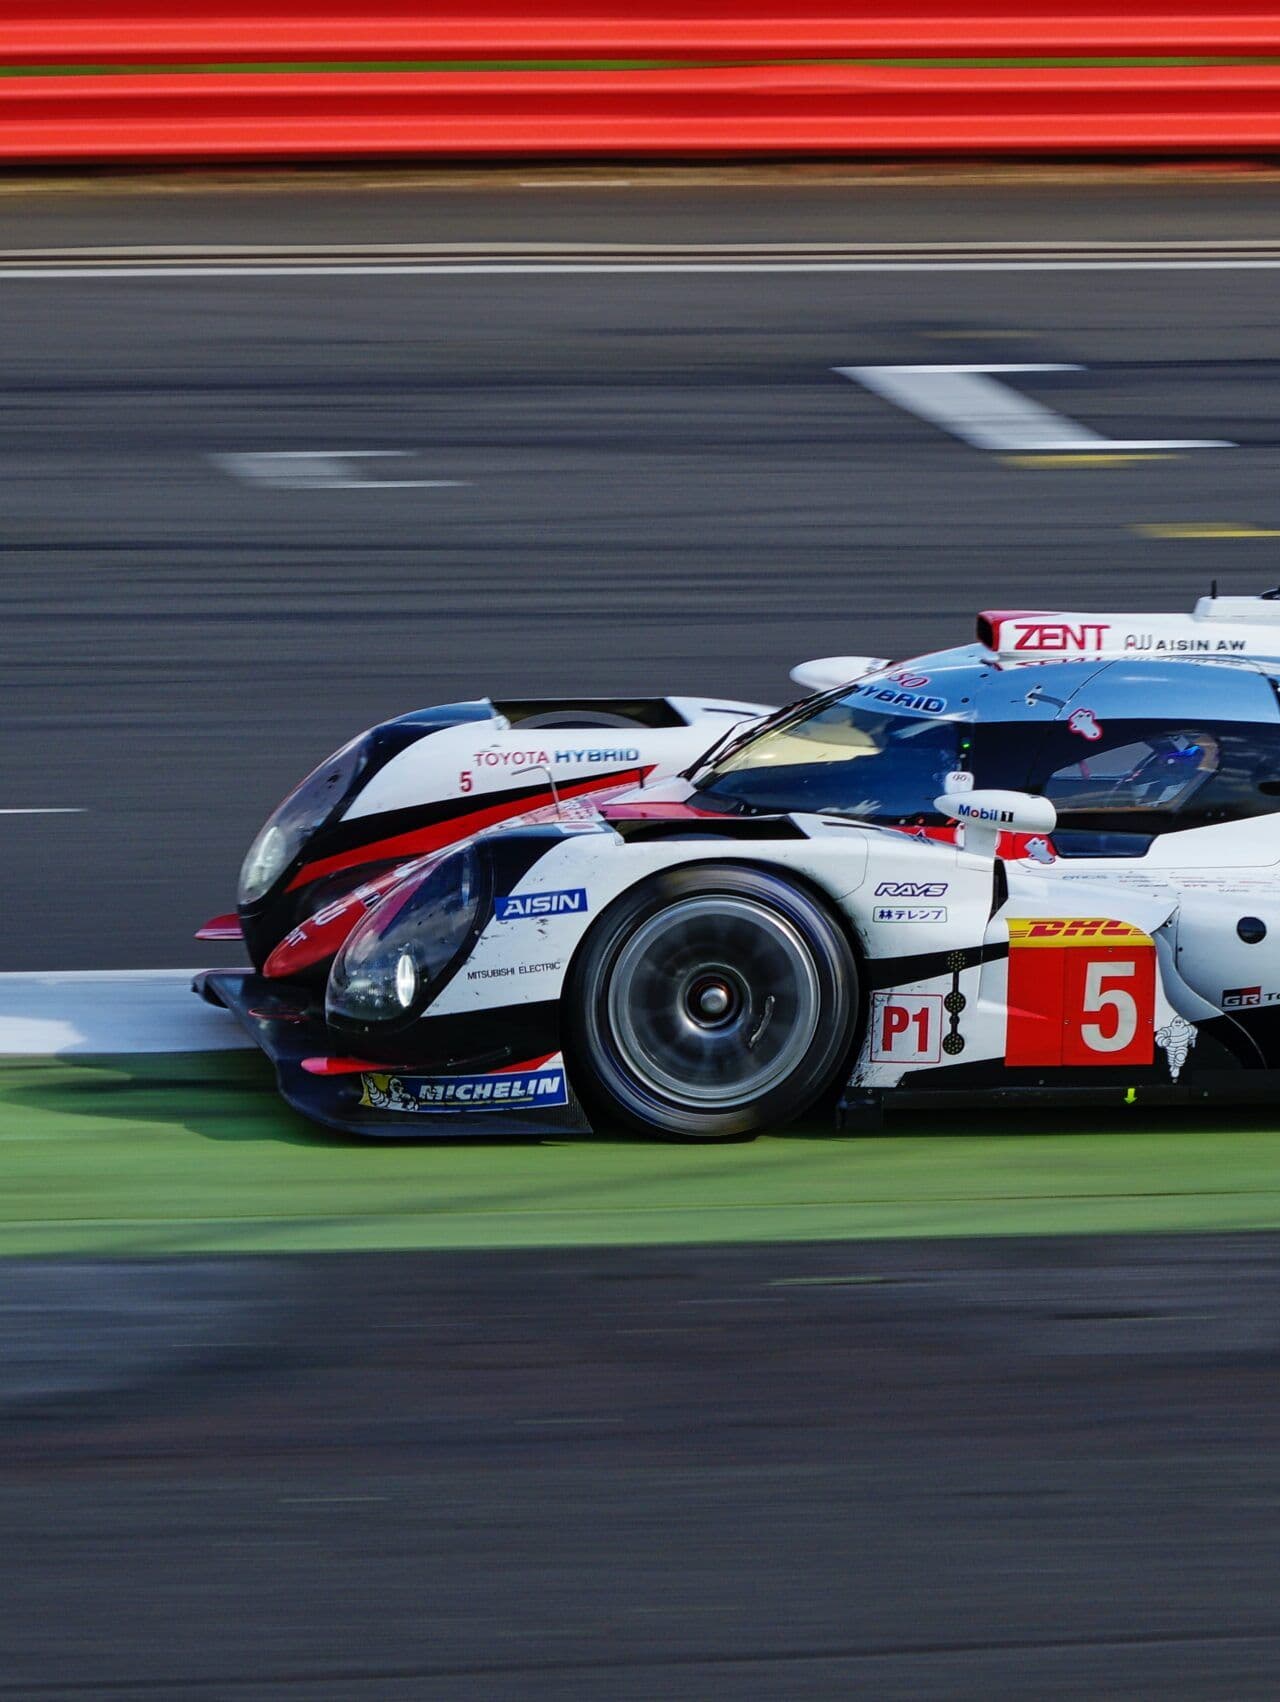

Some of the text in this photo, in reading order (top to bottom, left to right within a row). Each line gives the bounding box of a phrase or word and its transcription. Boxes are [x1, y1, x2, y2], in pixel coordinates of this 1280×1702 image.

[1013, 624, 1111, 651] ZENT
[1156, 639, 1210, 651] AISIN
[1215, 639, 1247, 651] AW
[474, 749, 639, 767] TOYOTA HYBRID
[459, 771, 473, 793] 5
[958, 804, 1014, 823] Mobil 1
[874, 882, 949, 897] RAYS
[503, 893, 580, 917] AISIN
[1027, 921, 1132, 937] DHL
[467, 962, 561, 981] MITSUBISHI ELECTRIC
[1081, 961, 1138, 1053] 5
[882, 1006, 929, 1052] P1
[419, 1077, 561, 1100] MICHELIN
